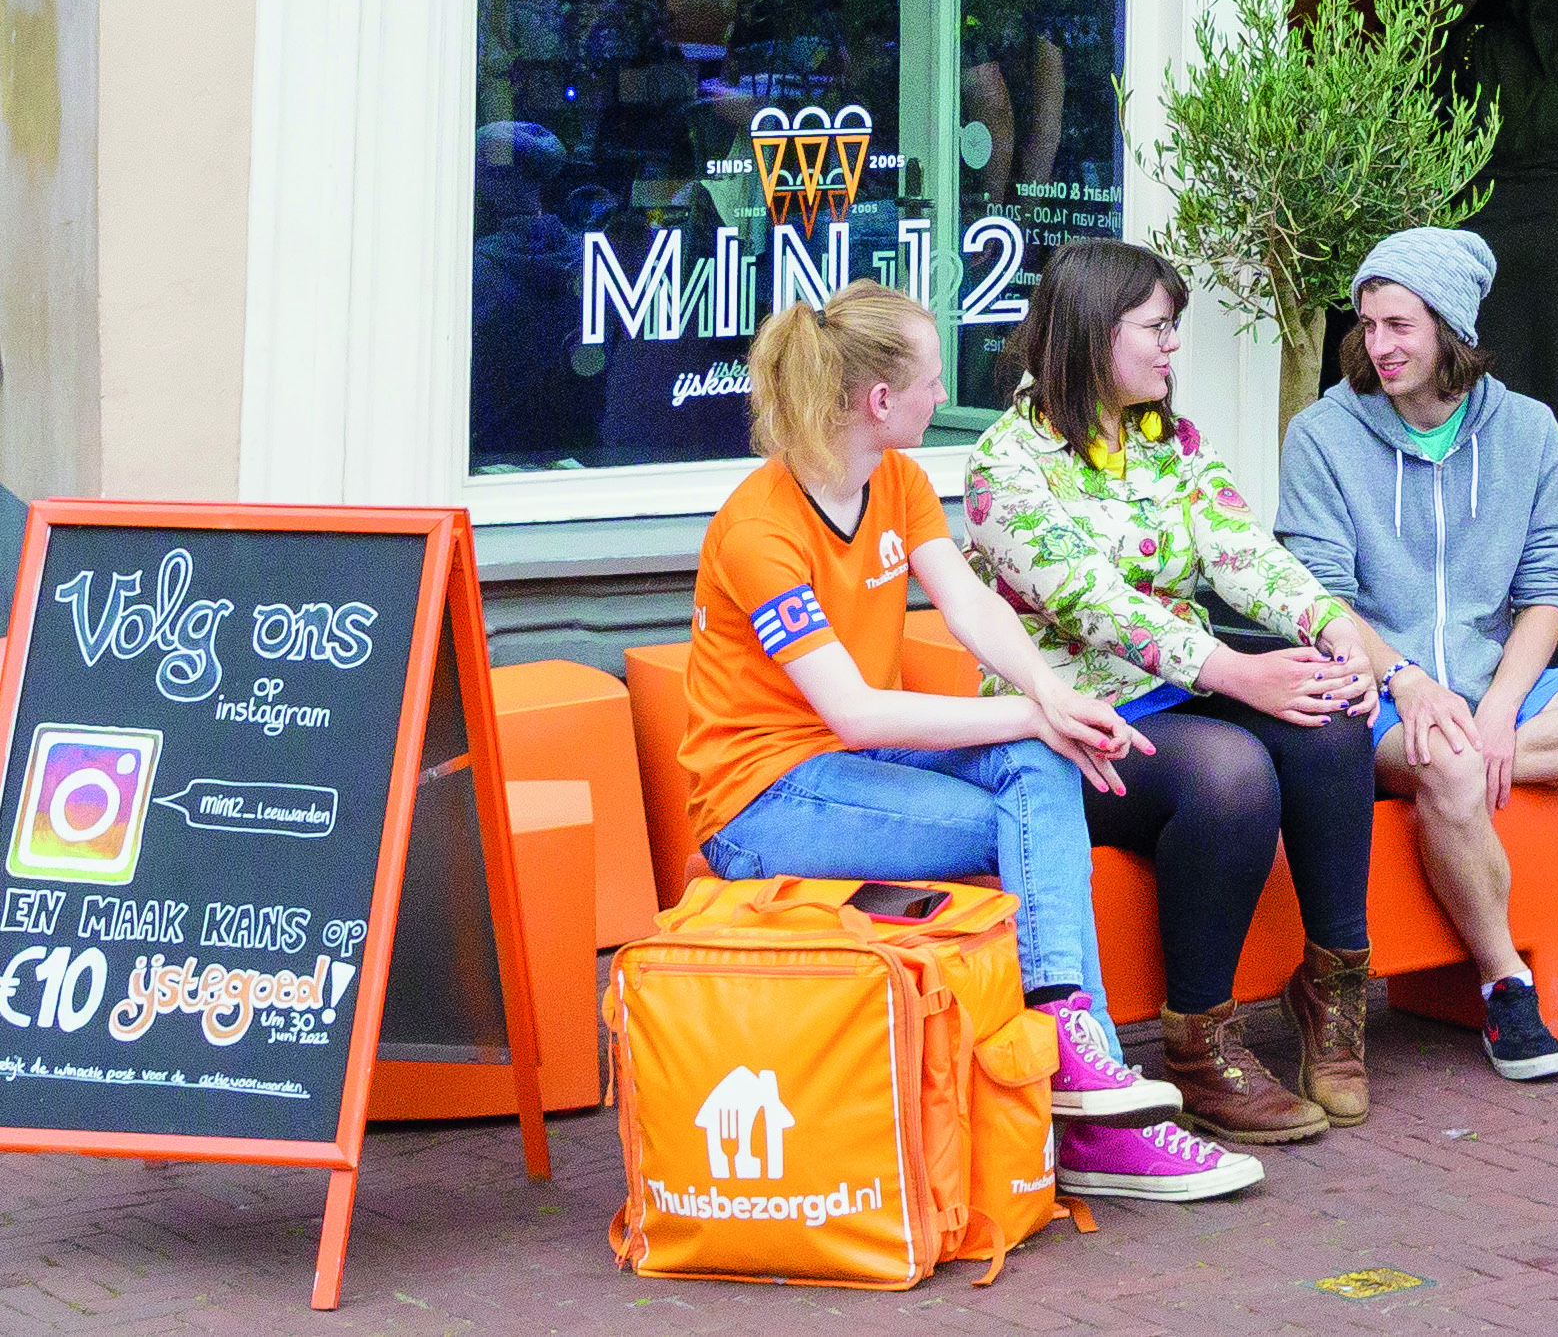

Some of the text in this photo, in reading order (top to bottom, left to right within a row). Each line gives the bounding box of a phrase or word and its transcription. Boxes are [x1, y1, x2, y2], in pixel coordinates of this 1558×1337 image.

[706, 154, 906, 174] SINDS 2005
[582, 216, 1030, 345] MIN 12
[671, 372, 753, 407] ijskou
[54, 547, 379, 703] Volg ons
[777, 595, 809, 632] C
[252, 677, 284, 702] op
[215, 695, 332, 737] instagram
[0, 886, 367, 958] EN MAAK KANS op
[0, 945, 108, 1033] €10
[289, 1011, 316, 1032] 30
[298, 1030, 330, 1045] 2022
[29, 1056, 50, 1076] de
[170, 1069, 187, 1084] de
[646, 1176, 883, 1228] Thuisbezorgd.nl
